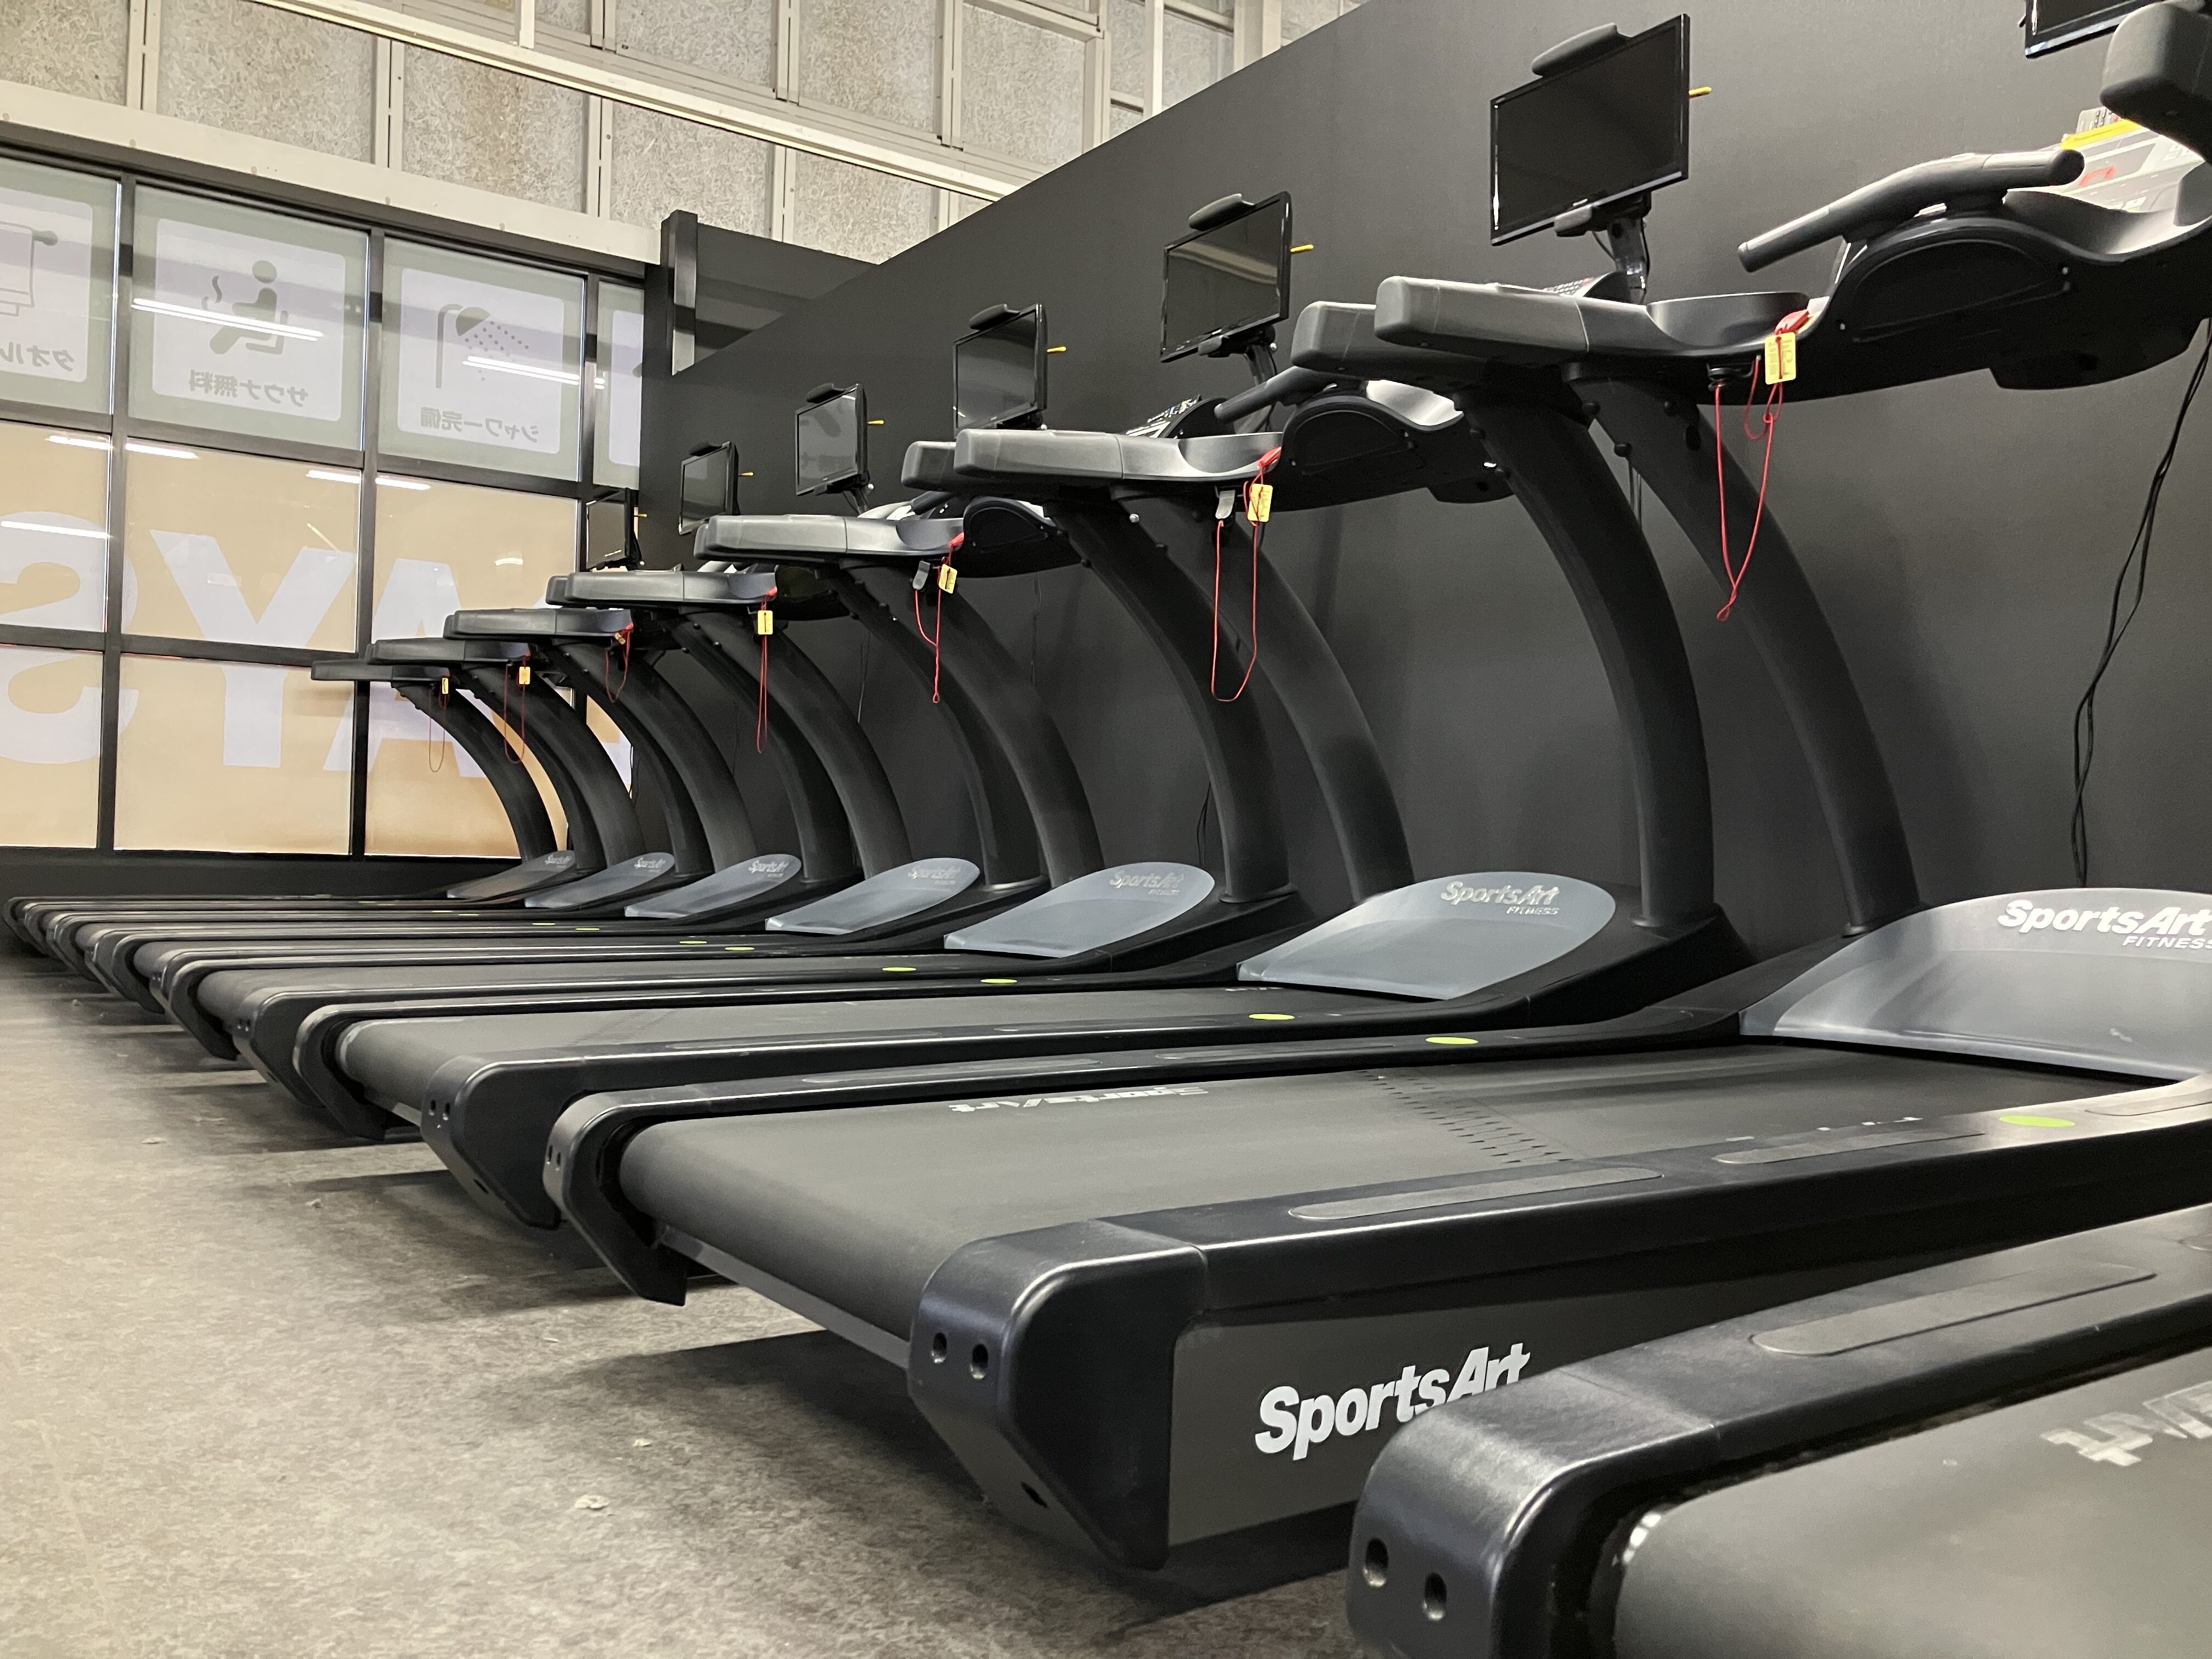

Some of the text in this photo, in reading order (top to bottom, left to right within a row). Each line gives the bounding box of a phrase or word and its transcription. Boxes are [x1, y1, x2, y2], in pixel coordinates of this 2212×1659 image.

[1441, 881, 1560, 905] SportsArt
[1997, 900, 2212, 936] SportsArt
[1255, 1343, 1530, 1460] SportsArt
